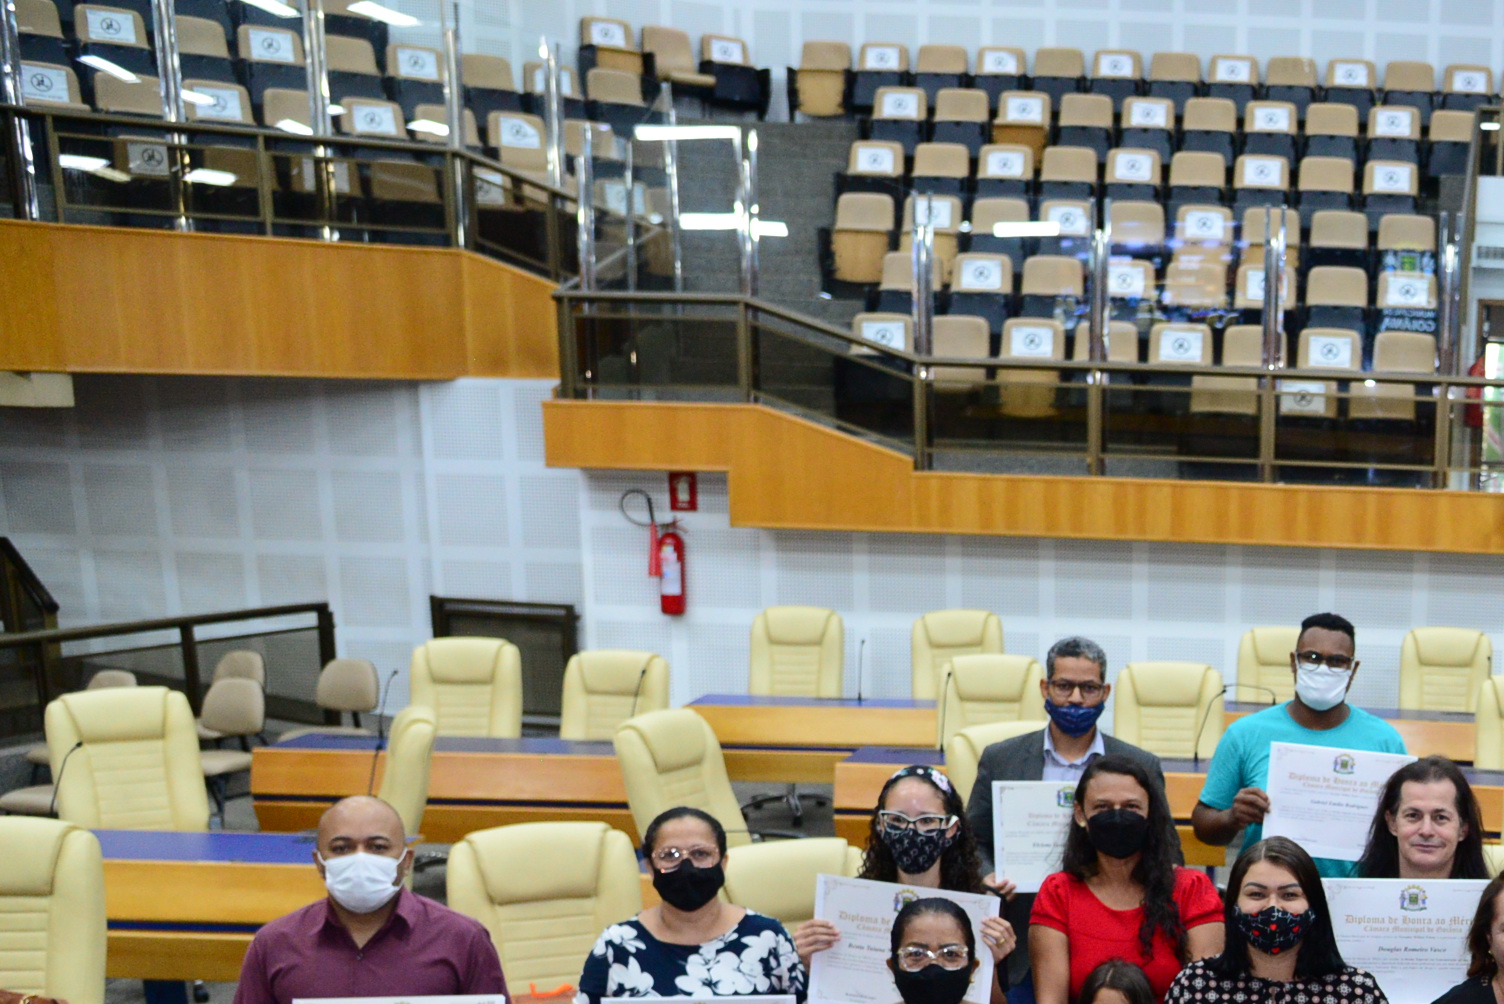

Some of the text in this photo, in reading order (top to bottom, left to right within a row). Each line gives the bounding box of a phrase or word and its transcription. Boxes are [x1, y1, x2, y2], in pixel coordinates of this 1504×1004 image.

[1345, 915, 1385, 924] Diploma
[1388, 916, 1398, 924] de
[1402, 915, 1432, 924] Honra
[1449, 915, 1474, 925] Mér
